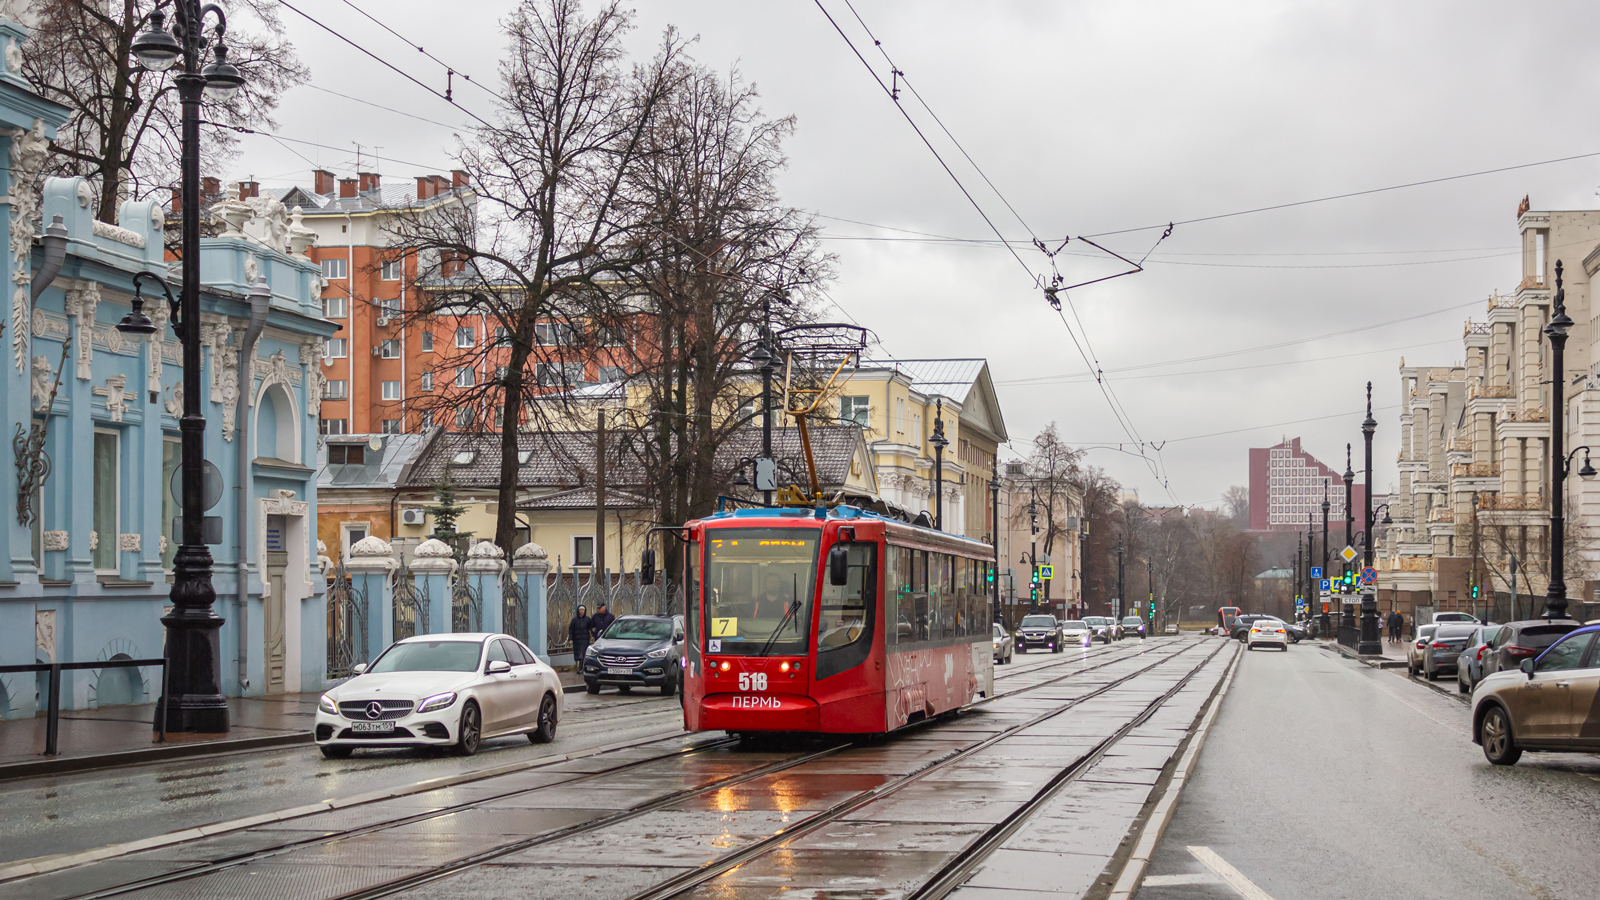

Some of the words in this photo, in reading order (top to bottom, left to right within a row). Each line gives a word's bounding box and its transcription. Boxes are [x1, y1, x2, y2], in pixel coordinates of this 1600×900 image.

[718, 619, 730, 635] 7
[738, 672, 768, 691] 518
[732, 696, 781, 708] ПЕРМЬ
